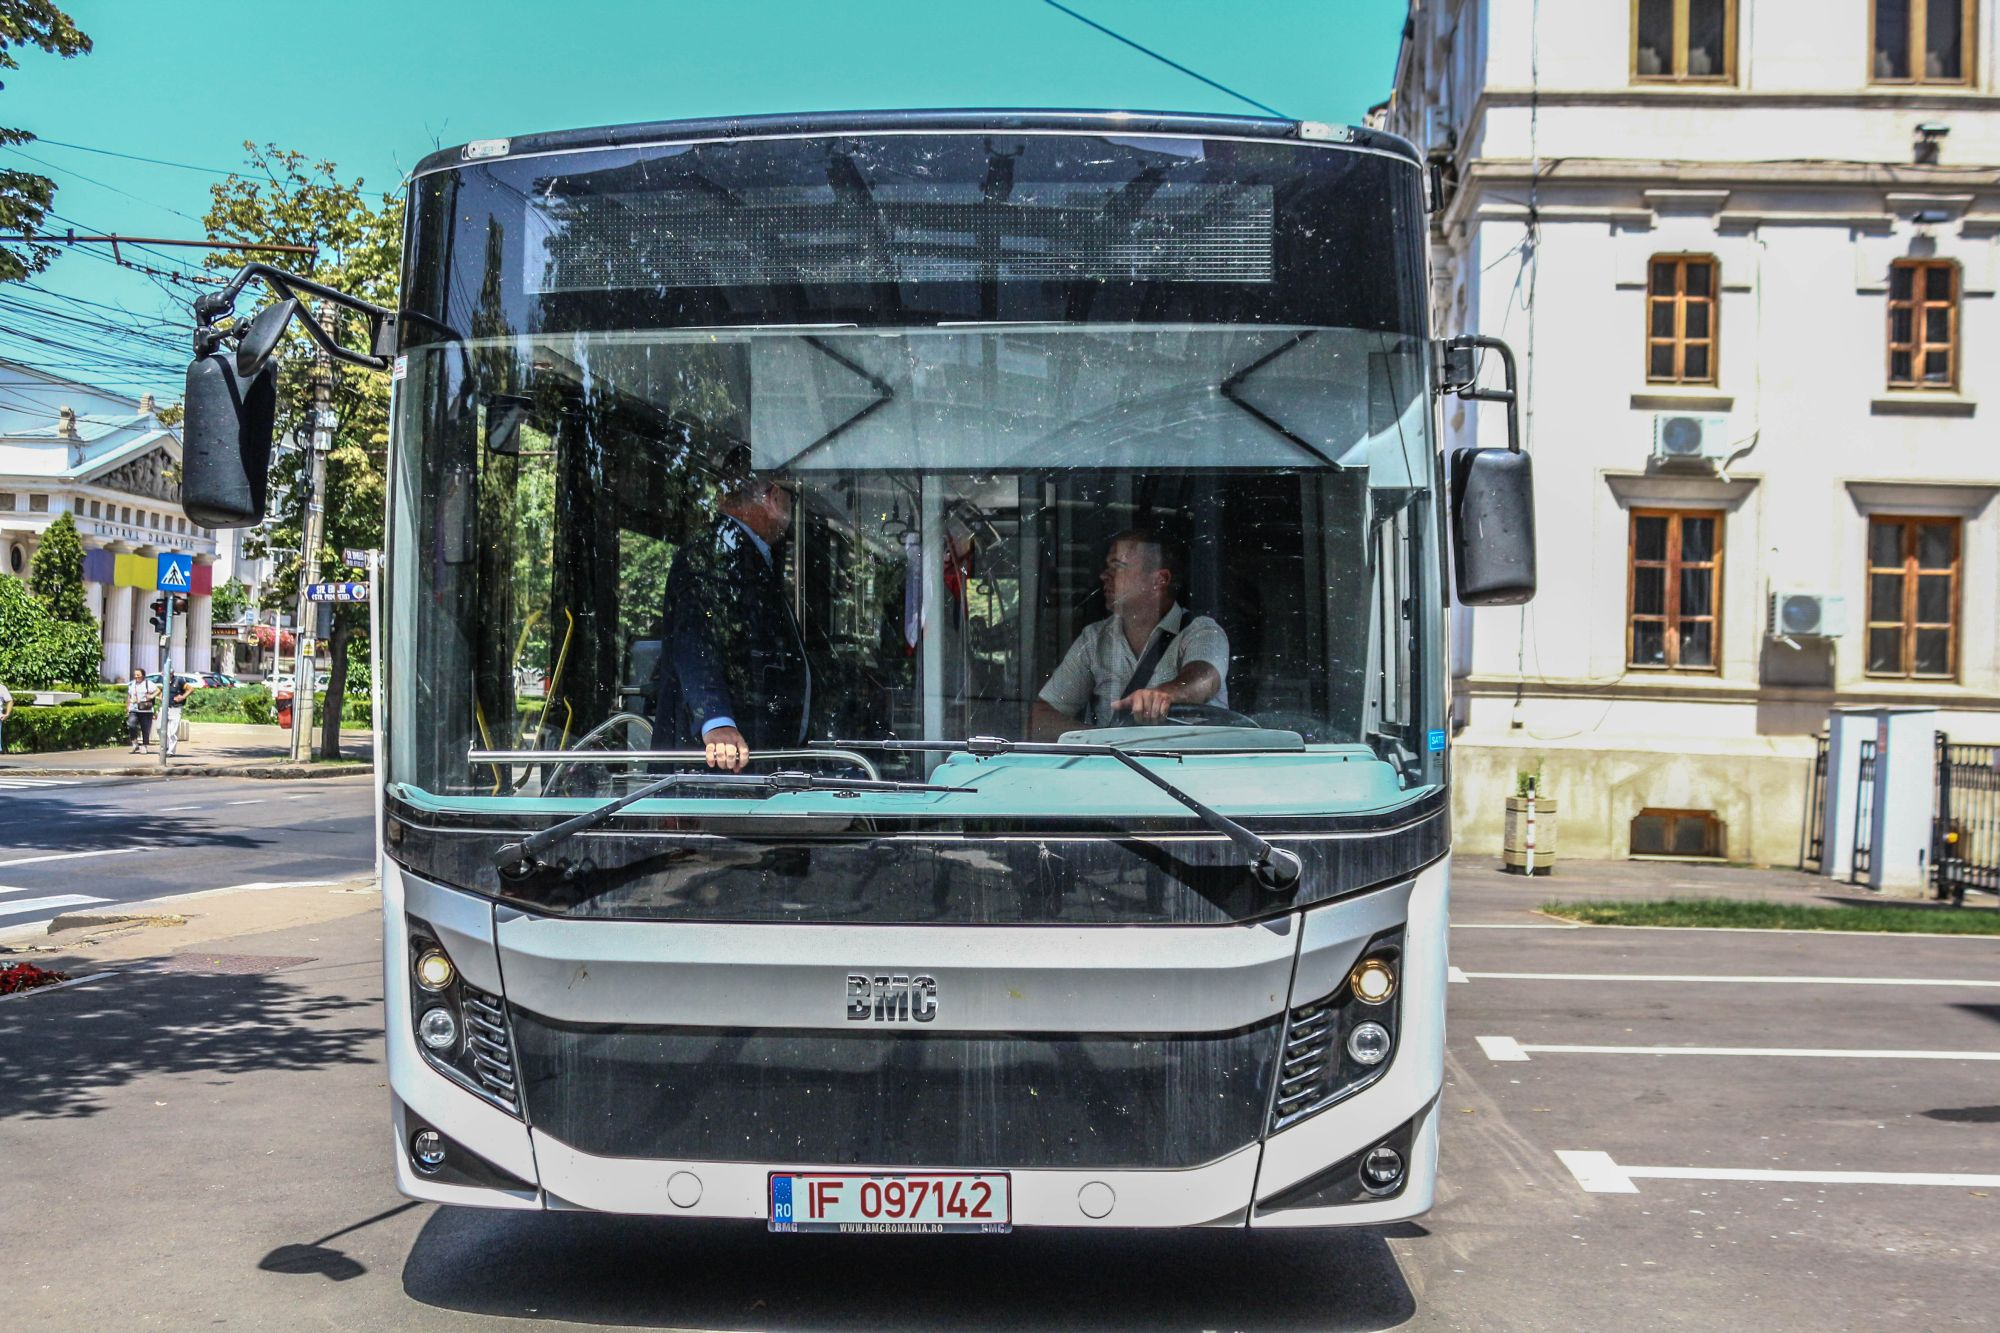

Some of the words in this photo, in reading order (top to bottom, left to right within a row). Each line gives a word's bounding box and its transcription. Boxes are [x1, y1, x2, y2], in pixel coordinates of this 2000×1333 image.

[846, 974, 938, 1022] BMC
[775, 1202, 792, 1218] RO
[808, 1181, 844, 1219] IF
[860, 1180, 993, 1219] 097142
[839, 1223, 944, 1233] WWW.BMCROMANIA.RO
